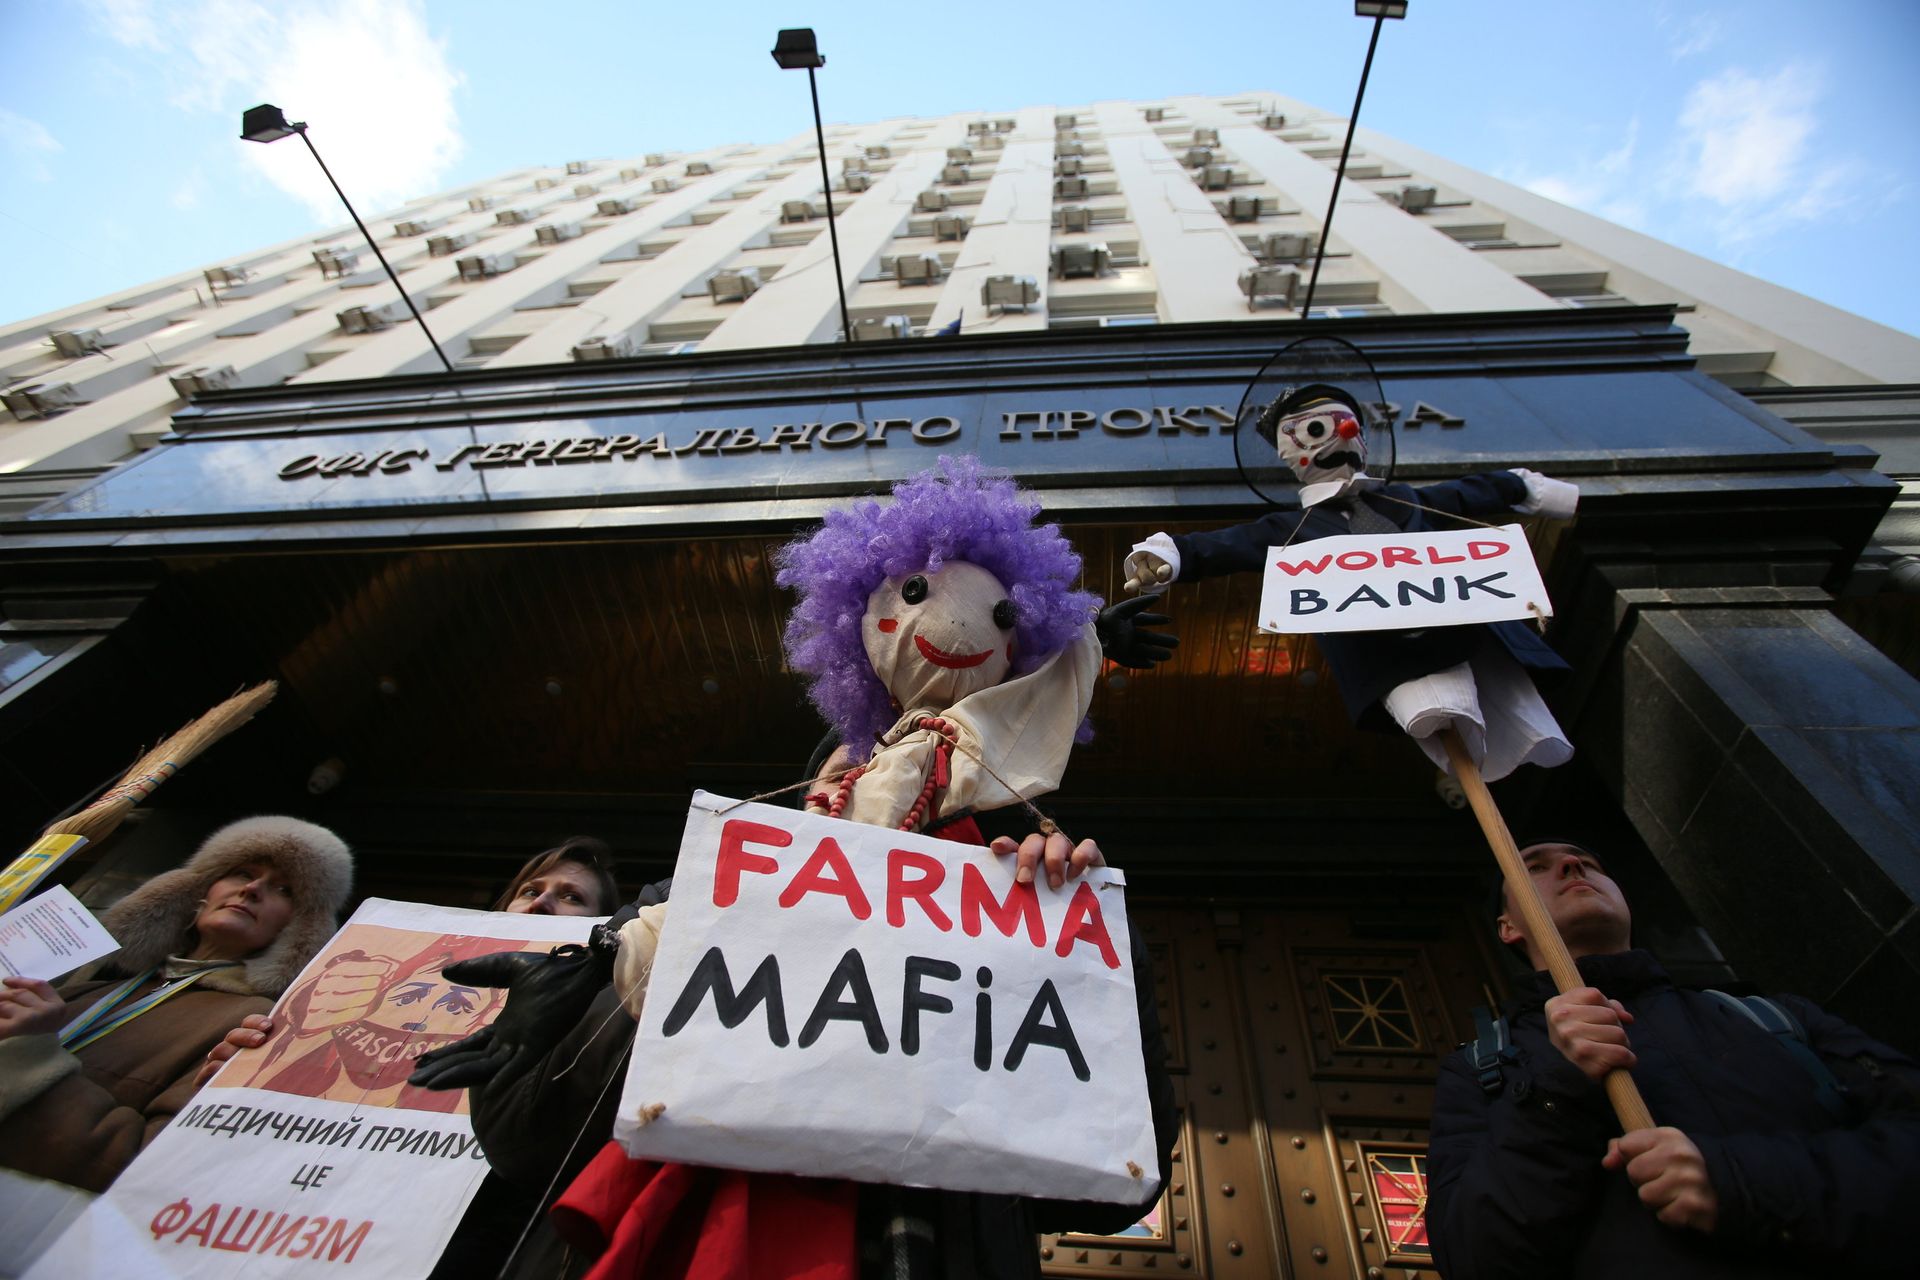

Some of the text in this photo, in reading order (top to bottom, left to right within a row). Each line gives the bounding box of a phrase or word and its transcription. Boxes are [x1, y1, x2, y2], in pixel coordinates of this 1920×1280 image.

[277, 401, 1465, 481] ОФІС ГЕНЕРАЛЬНОГО ПРОКУРА
[1276, 541, 1510, 577] WORLD
[1289, 571, 1516, 615] BANK
[713, 819, 1122, 970] FARMA
[344, 1026, 458, 1064] FASCISM
[177, 1104, 364, 1147] МЕДИЧНИЙ
[291, 1163, 334, 1191] ЦЕ
[150, 1197, 375, 1264] ФАШИЗМ
